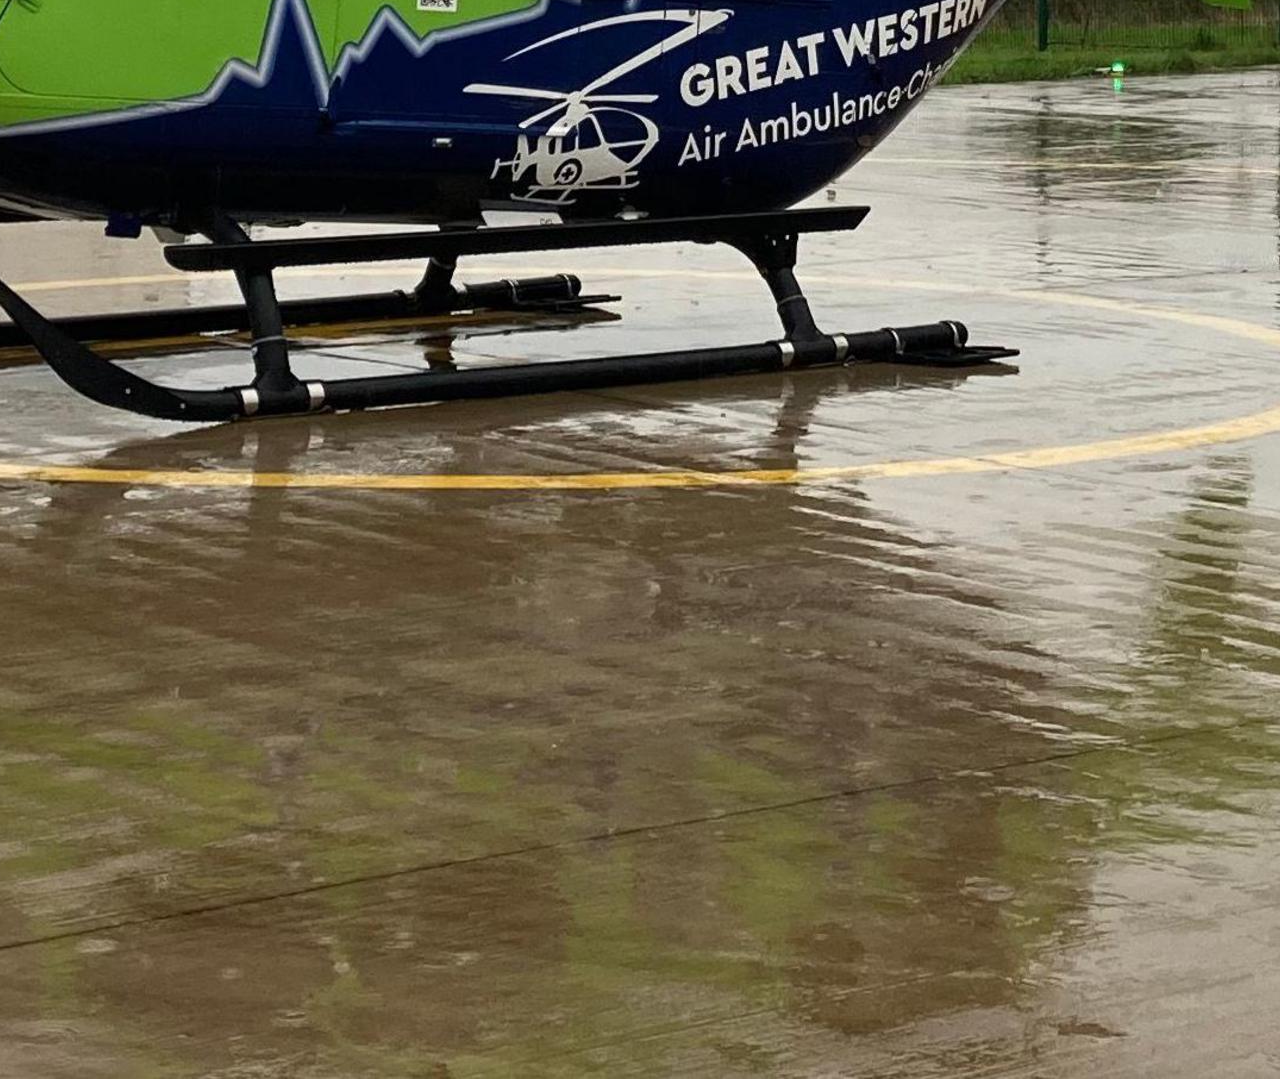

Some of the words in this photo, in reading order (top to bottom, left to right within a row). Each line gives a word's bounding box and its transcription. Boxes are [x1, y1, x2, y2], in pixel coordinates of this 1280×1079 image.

[679, 32, 825, 108] GREAT
[677, 124, 727, 167] Air
[734, 83, 899, 153] Ambulance
